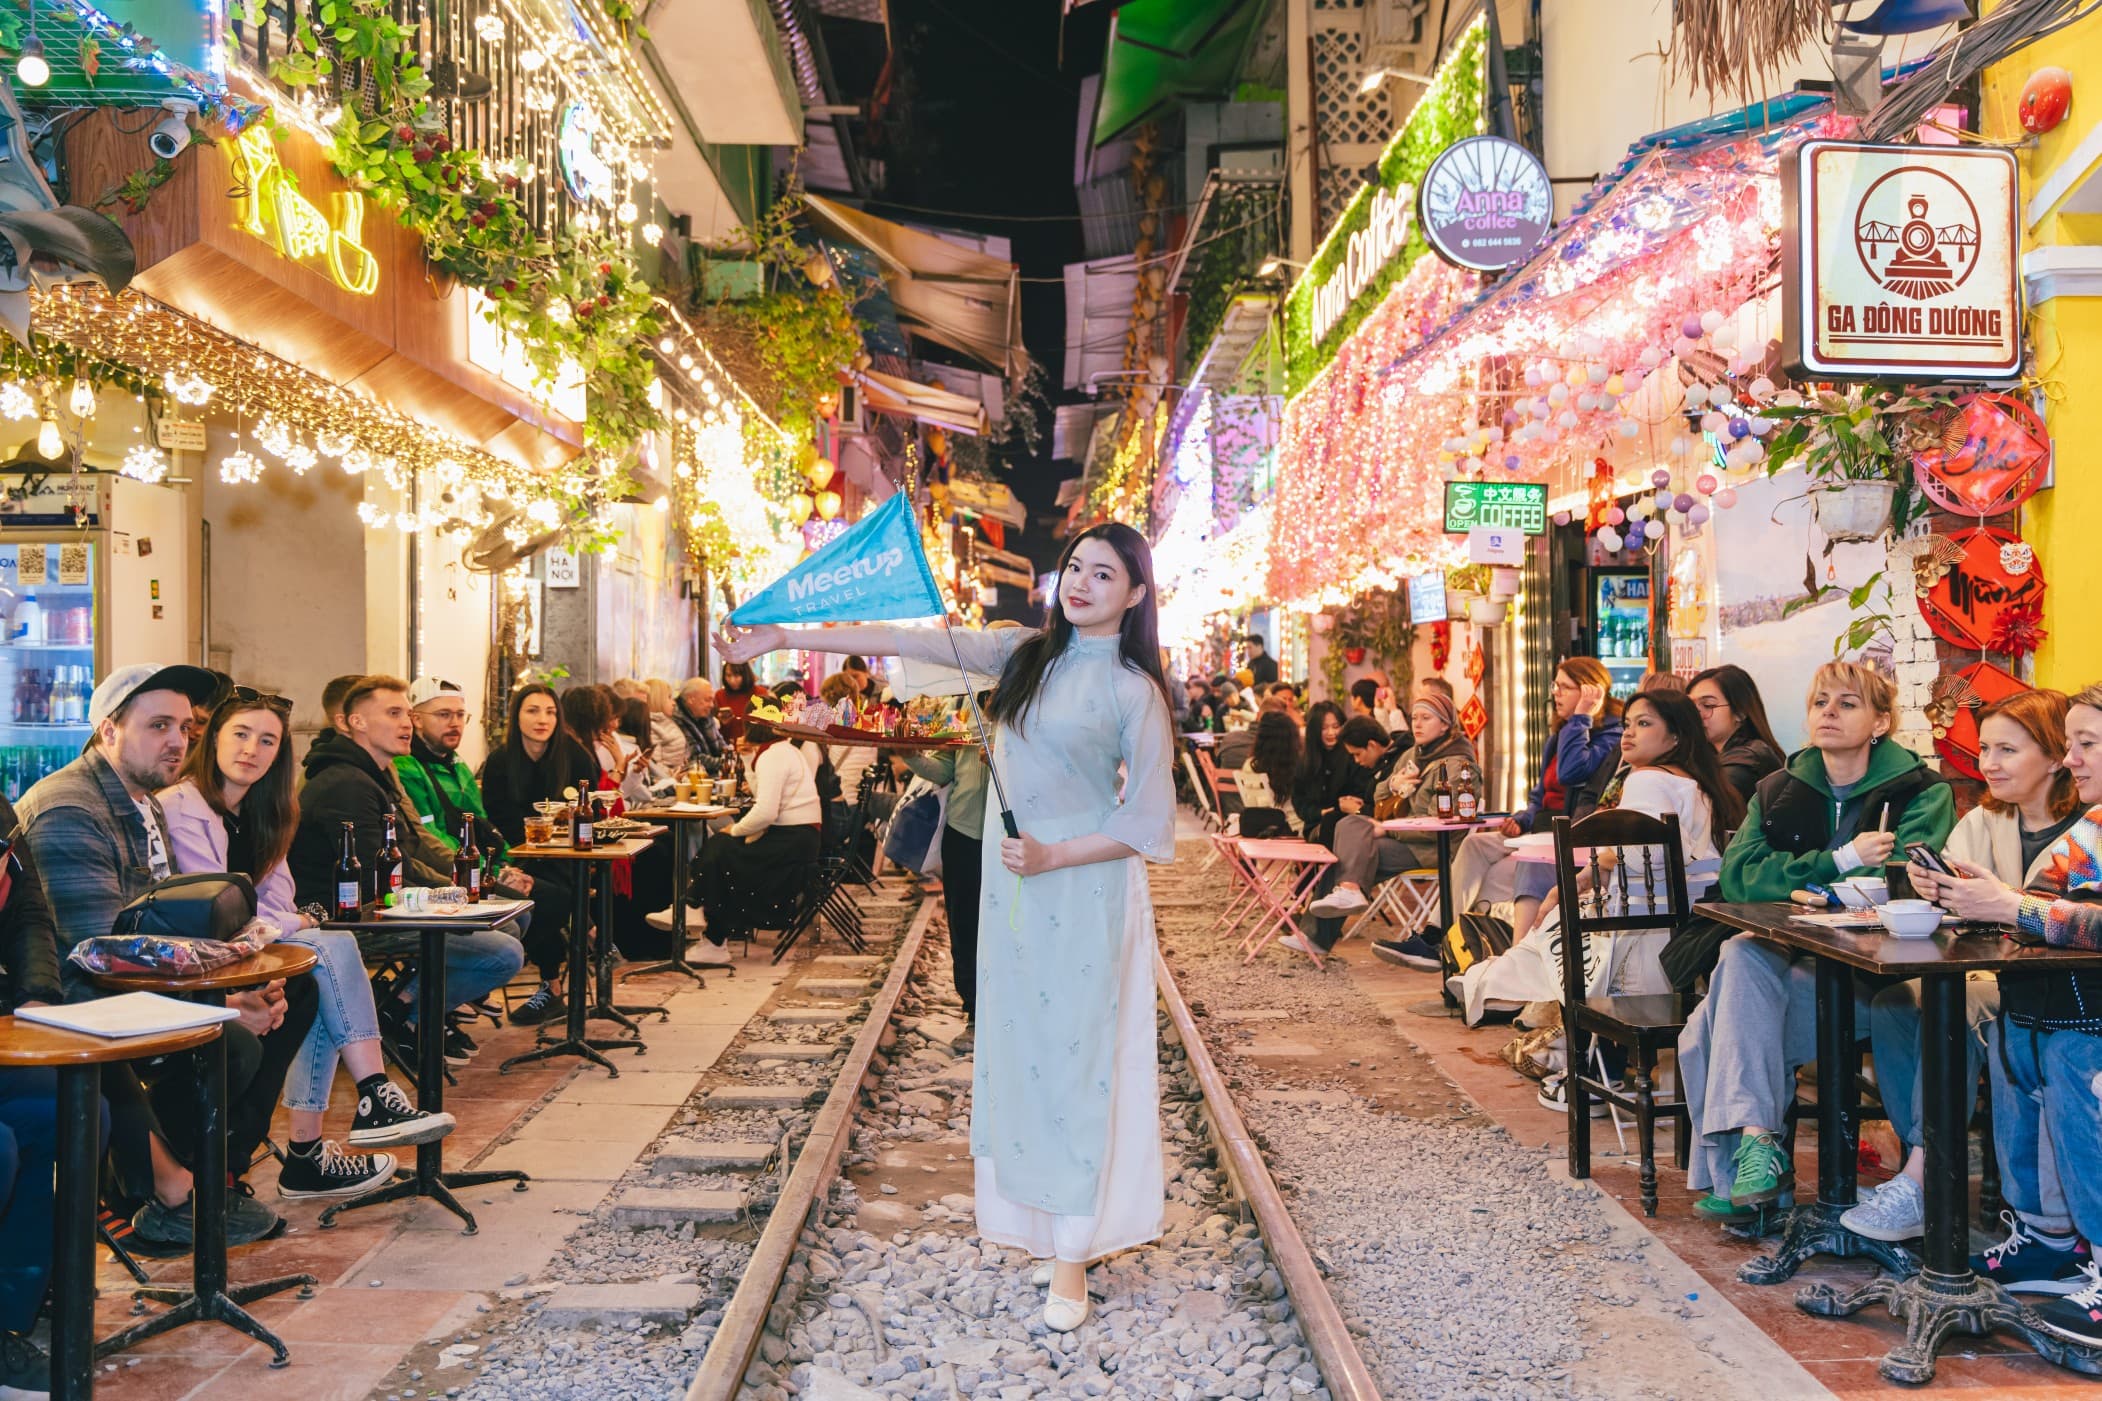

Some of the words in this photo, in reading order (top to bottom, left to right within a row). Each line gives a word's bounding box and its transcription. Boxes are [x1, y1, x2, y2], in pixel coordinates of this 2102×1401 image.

[1457, 189, 1524, 213] Anna
[1463, 212, 1518, 231] coffee
[1311, 262, 1348, 349] Anna
[1347, 182, 1414, 301] Coffee
[1827, 304, 1857, 333] GA
[1863, 301, 1922, 335] ĐÔNG
[1928, 305, 2002, 337] DƯƠNG
[1449, 519, 1478, 529] OPEN
[1480, 504, 1541, 529] COFFEE
[551, 557, 569, 566] HA
[551, 570, 574, 580] NOI
[787, 547, 904, 603] Meetup
[792, 586, 867, 617] TRAVEL
